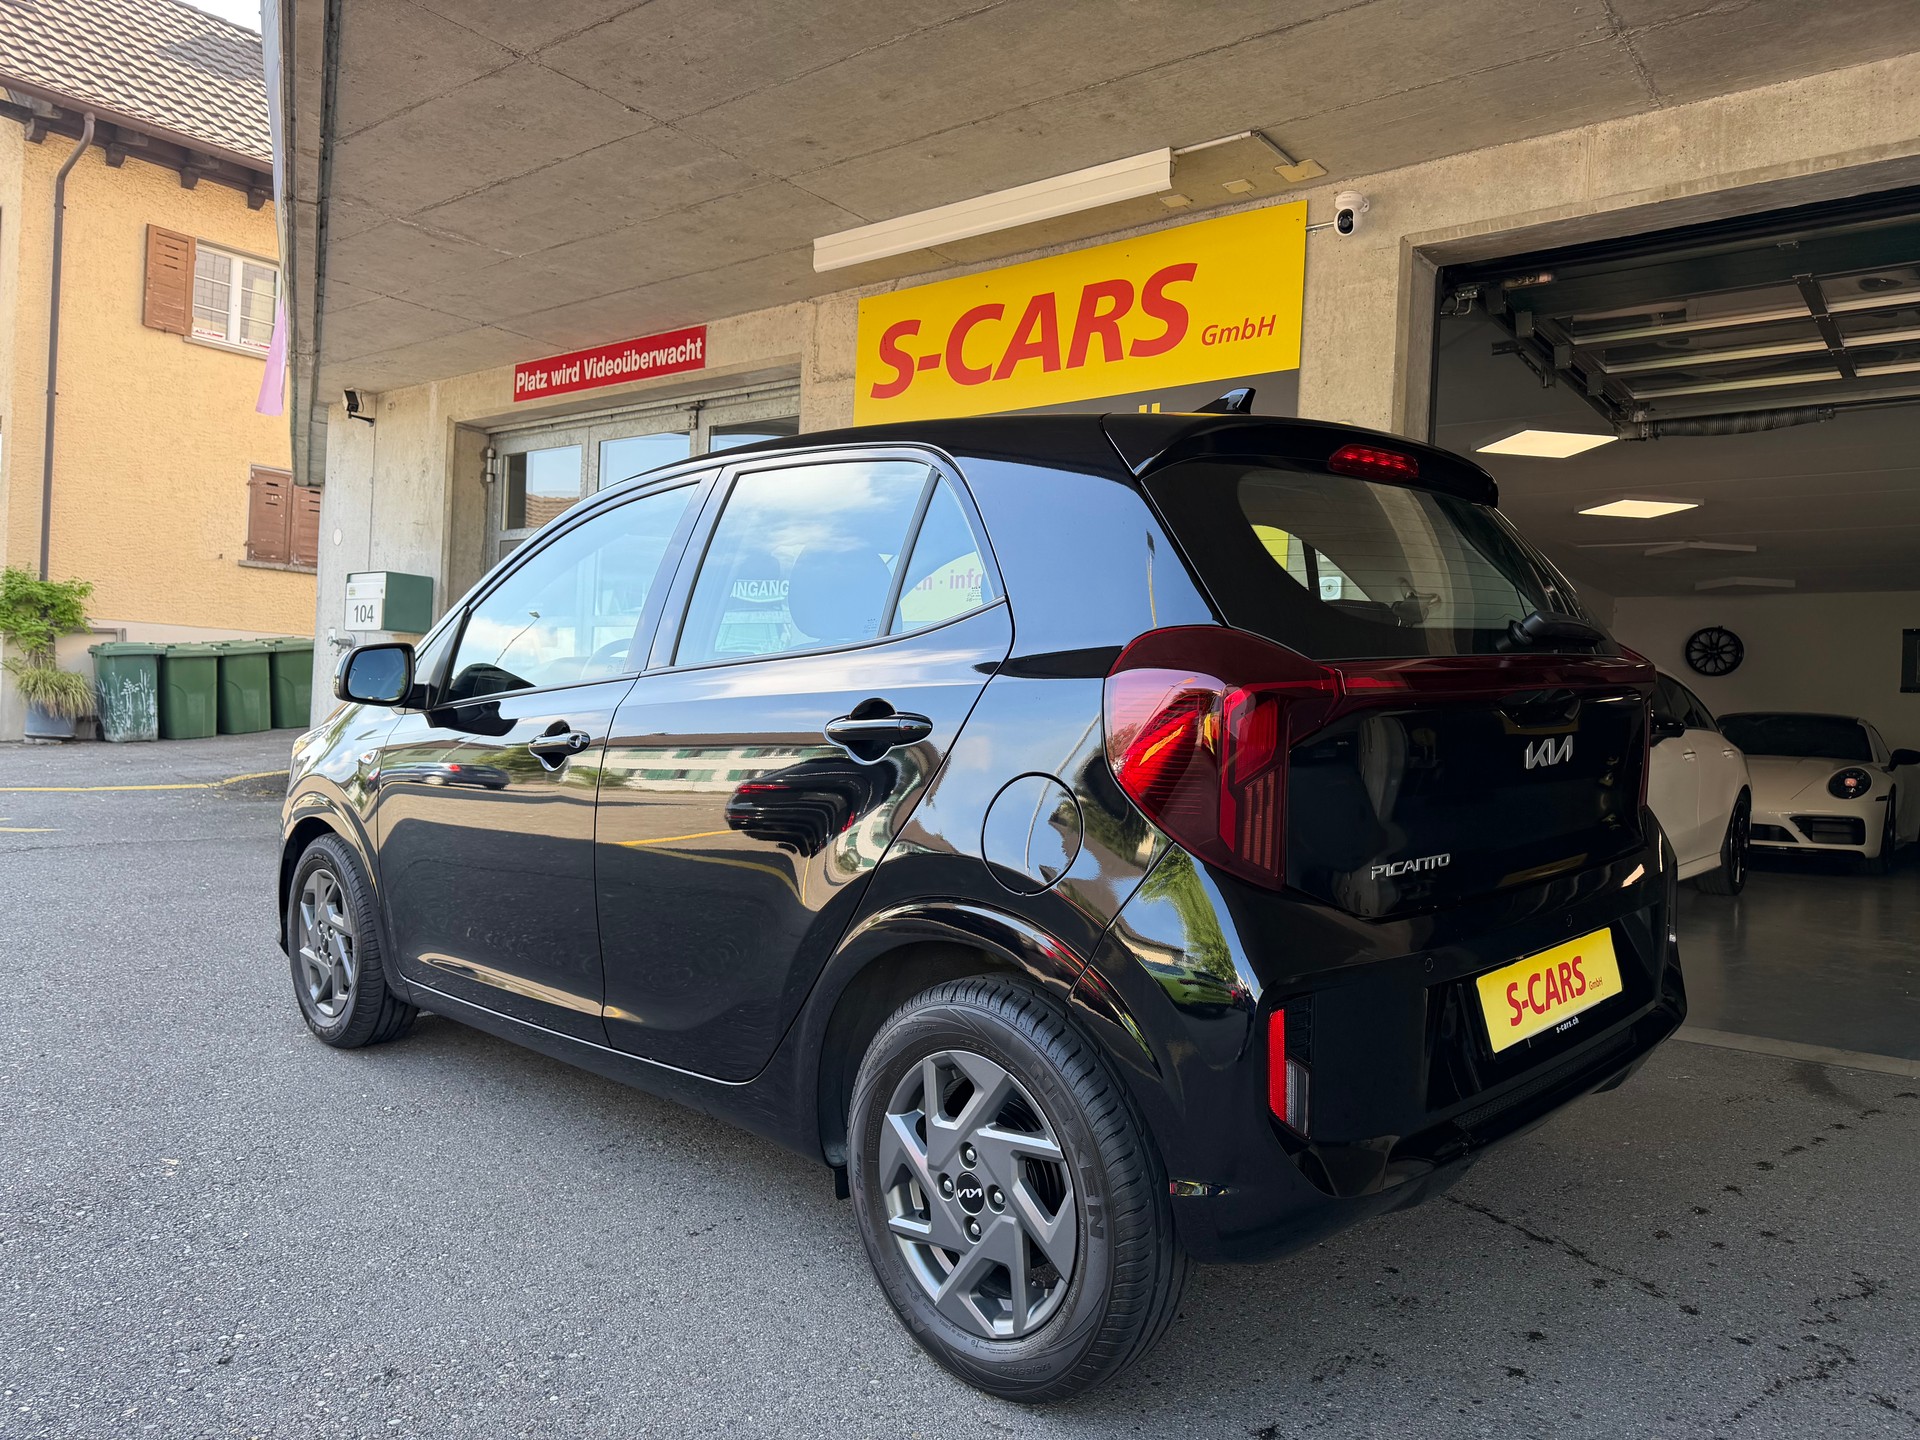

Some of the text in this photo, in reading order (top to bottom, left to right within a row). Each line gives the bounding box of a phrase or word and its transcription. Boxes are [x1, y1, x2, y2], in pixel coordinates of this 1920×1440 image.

[870, 262, 1276, 399] S-CARS GmbH
[515, 336, 703, 394] Platz wird Videoüberwacht
[730, 580, 789, 598] INGANG
[354, 604, 374, 623] 104
[1525, 735, 1574, 770] KIA
[1371, 853, 1450, 880] PICANTO
[1506, 955, 1603, 1027] S-CARS GmbH
[1556, 1016, 1580, 1034] s-cars.ch
